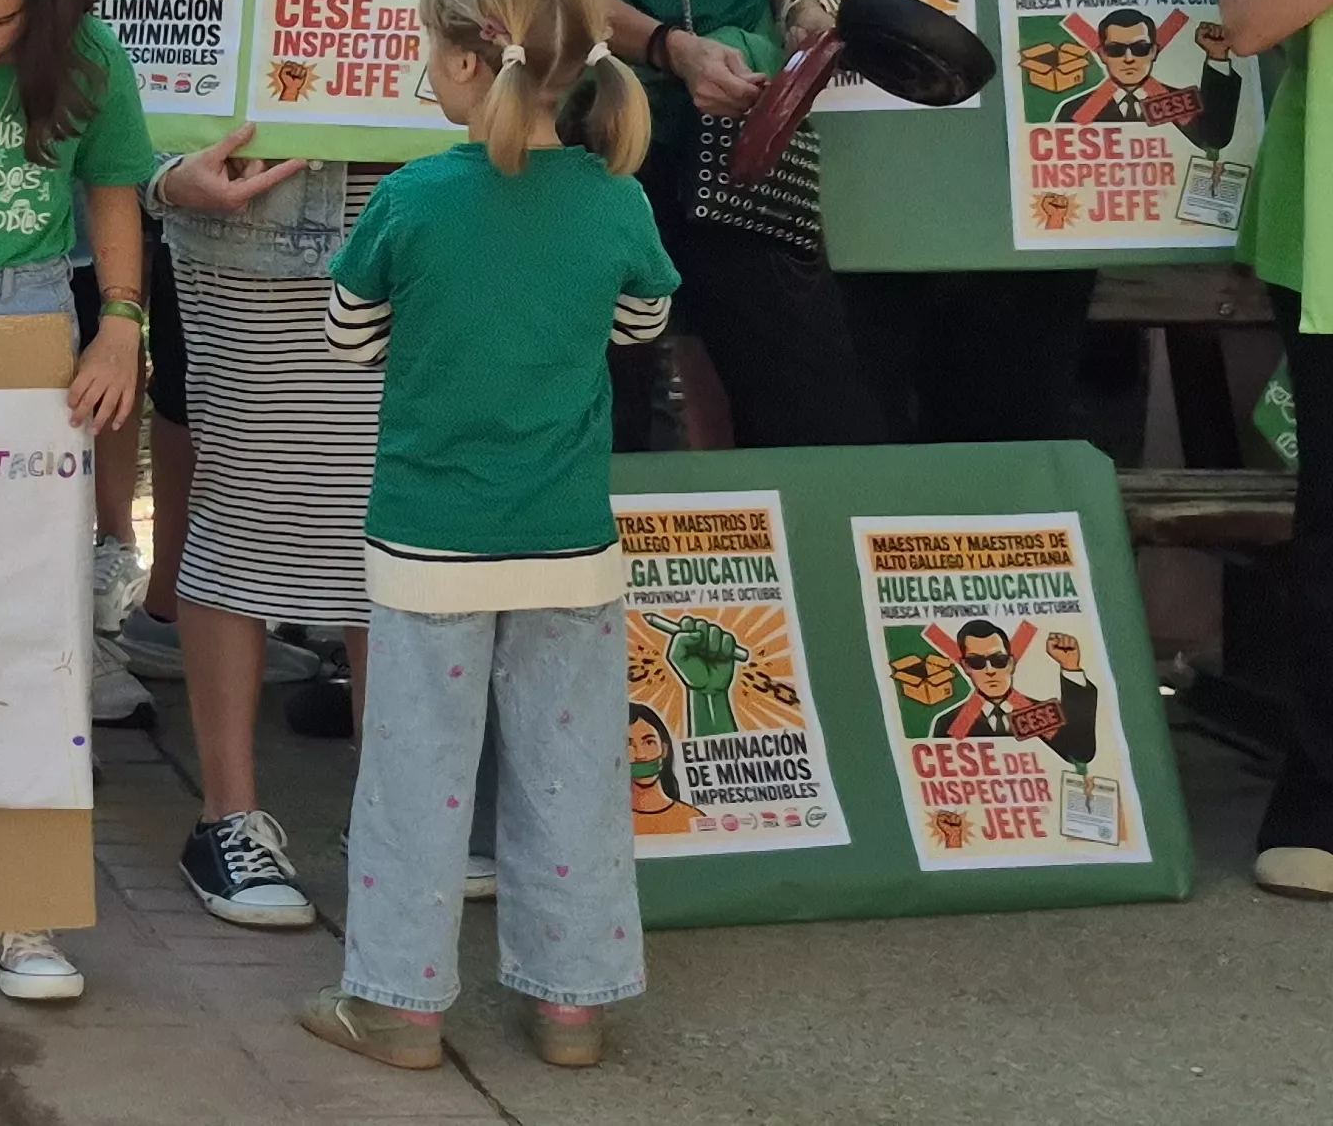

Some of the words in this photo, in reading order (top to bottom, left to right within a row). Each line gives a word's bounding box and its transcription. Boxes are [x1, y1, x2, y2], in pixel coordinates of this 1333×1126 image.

[118, 20, 222, 47] MÍNIMOS
[377, 7, 421, 31] DEL
[273, 30, 421, 61] INSPECTOR
[1029, 127, 1125, 162] CESE
[1130, 137, 1173, 160] DEL
[1032, 161, 1176, 189] INSPECTOR
[659, 515, 669, 533] Y
[672, 514, 746, 534] MAESTROS
[750, 513, 768, 531] DE
[684, 534, 703, 552] LA
[707, 533, 772, 552] JACETANIA
[872, 534, 950, 553] MAESTRAS
[967, 533, 1044, 552] MAESTROS
[1048, 531, 1069, 550] DE
[666, 555, 779, 586] EDUCATIVA
[874, 553, 906, 571] ALTO
[909, 552, 964, 570] GALLEGO
[978, 552, 995, 569] LA
[999, 549, 1073, 568] JACETANIA
[738, 587, 782, 602] OCTUBRE
[876, 574, 958, 604] HUELGA
[962, 571, 1079, 602] EDUCATIVA
[682, 730, 808, 764] ELIMINACIÓN
[911, 742, 1002, 780] CESE
[1003, 751, 1046, 774] DEL
[686, 764, 713, 788] DE
[718, 757, 812, 785] MÍNIMOS
[919, 777, 1053, 807] INSPECTOR
